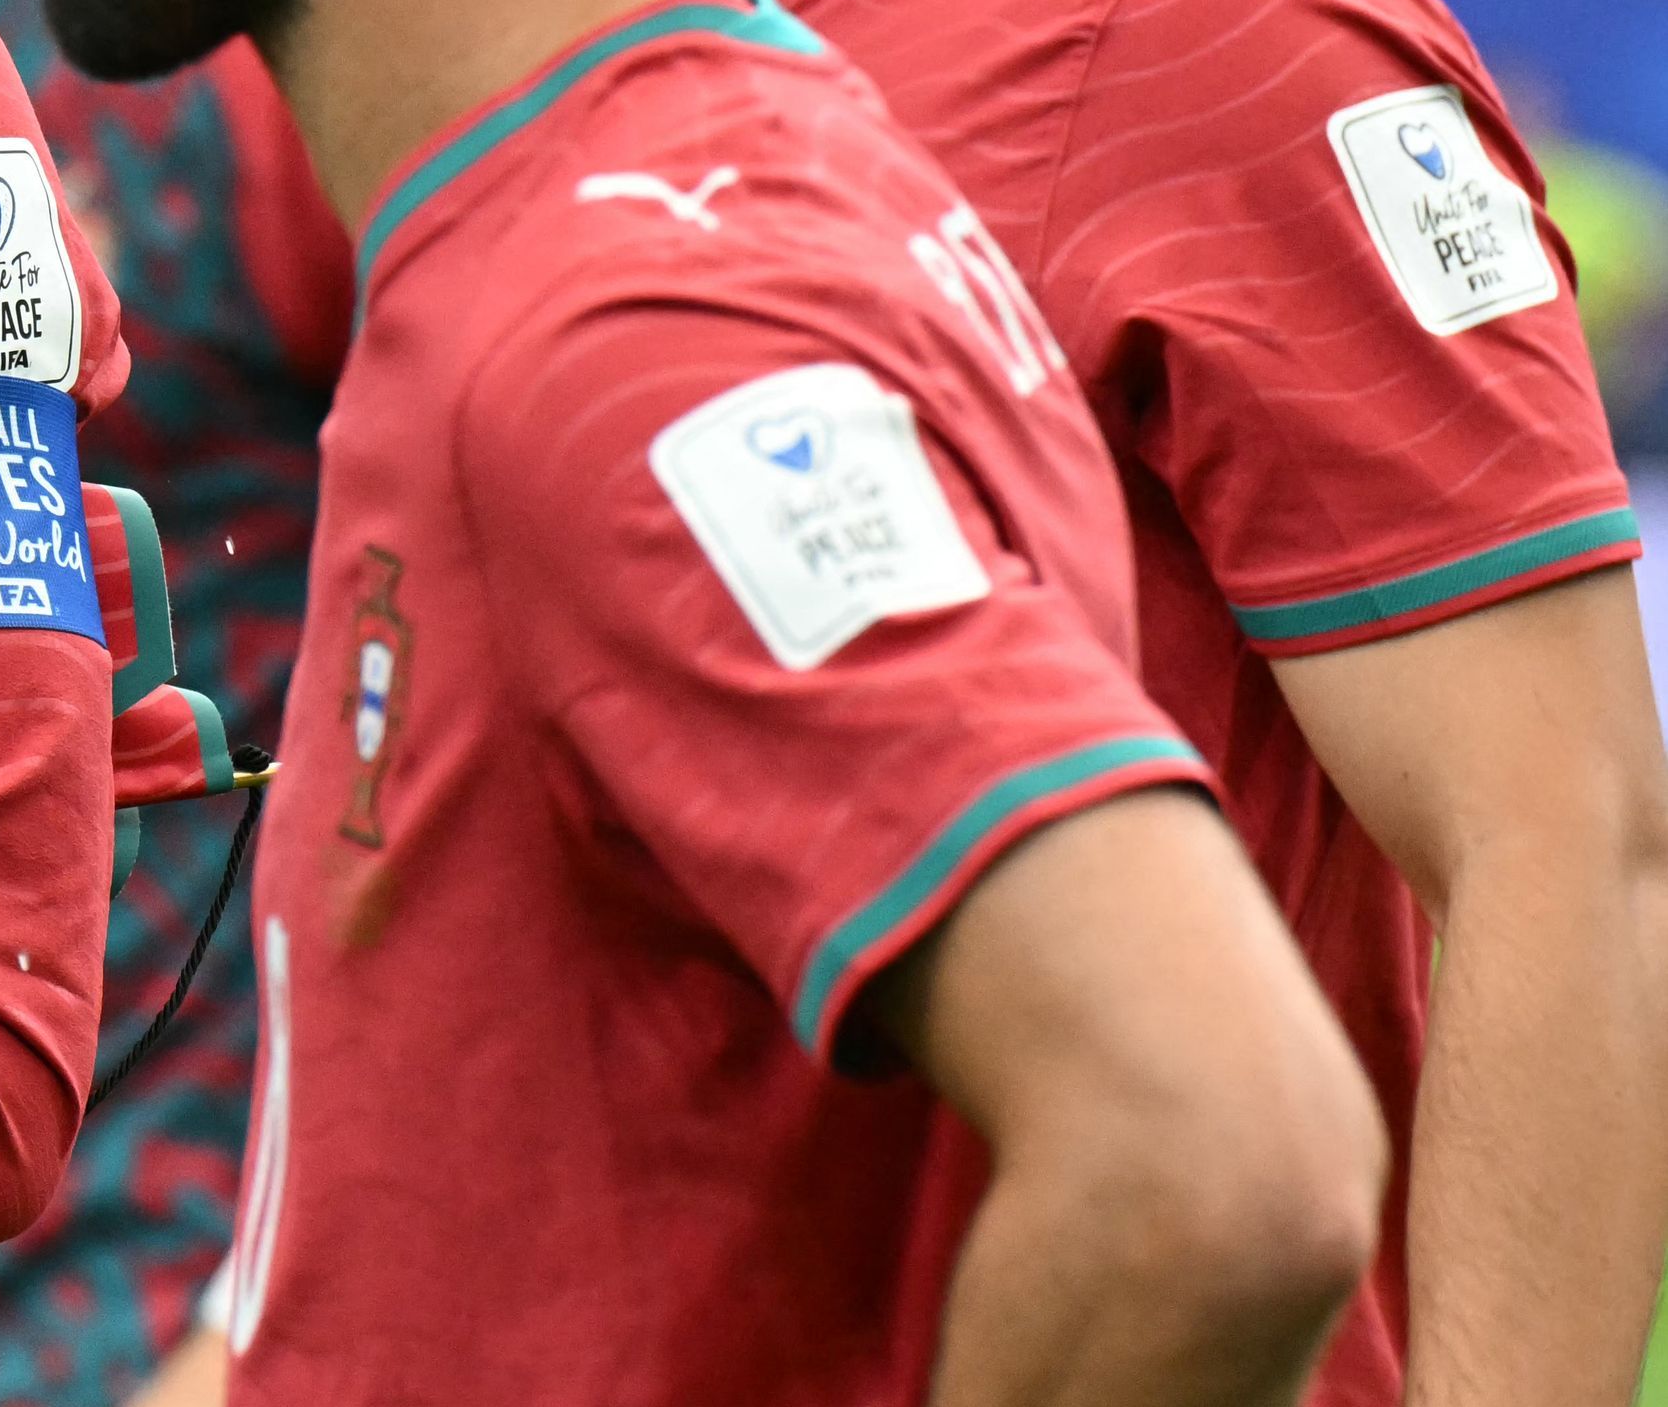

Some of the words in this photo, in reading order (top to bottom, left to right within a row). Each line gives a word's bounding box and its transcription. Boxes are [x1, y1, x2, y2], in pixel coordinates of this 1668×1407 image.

[1414, 191, 1461, 235] Unite
[1434, 222, 1504, 274] PEACE
[12, 251, 40, 294] For
